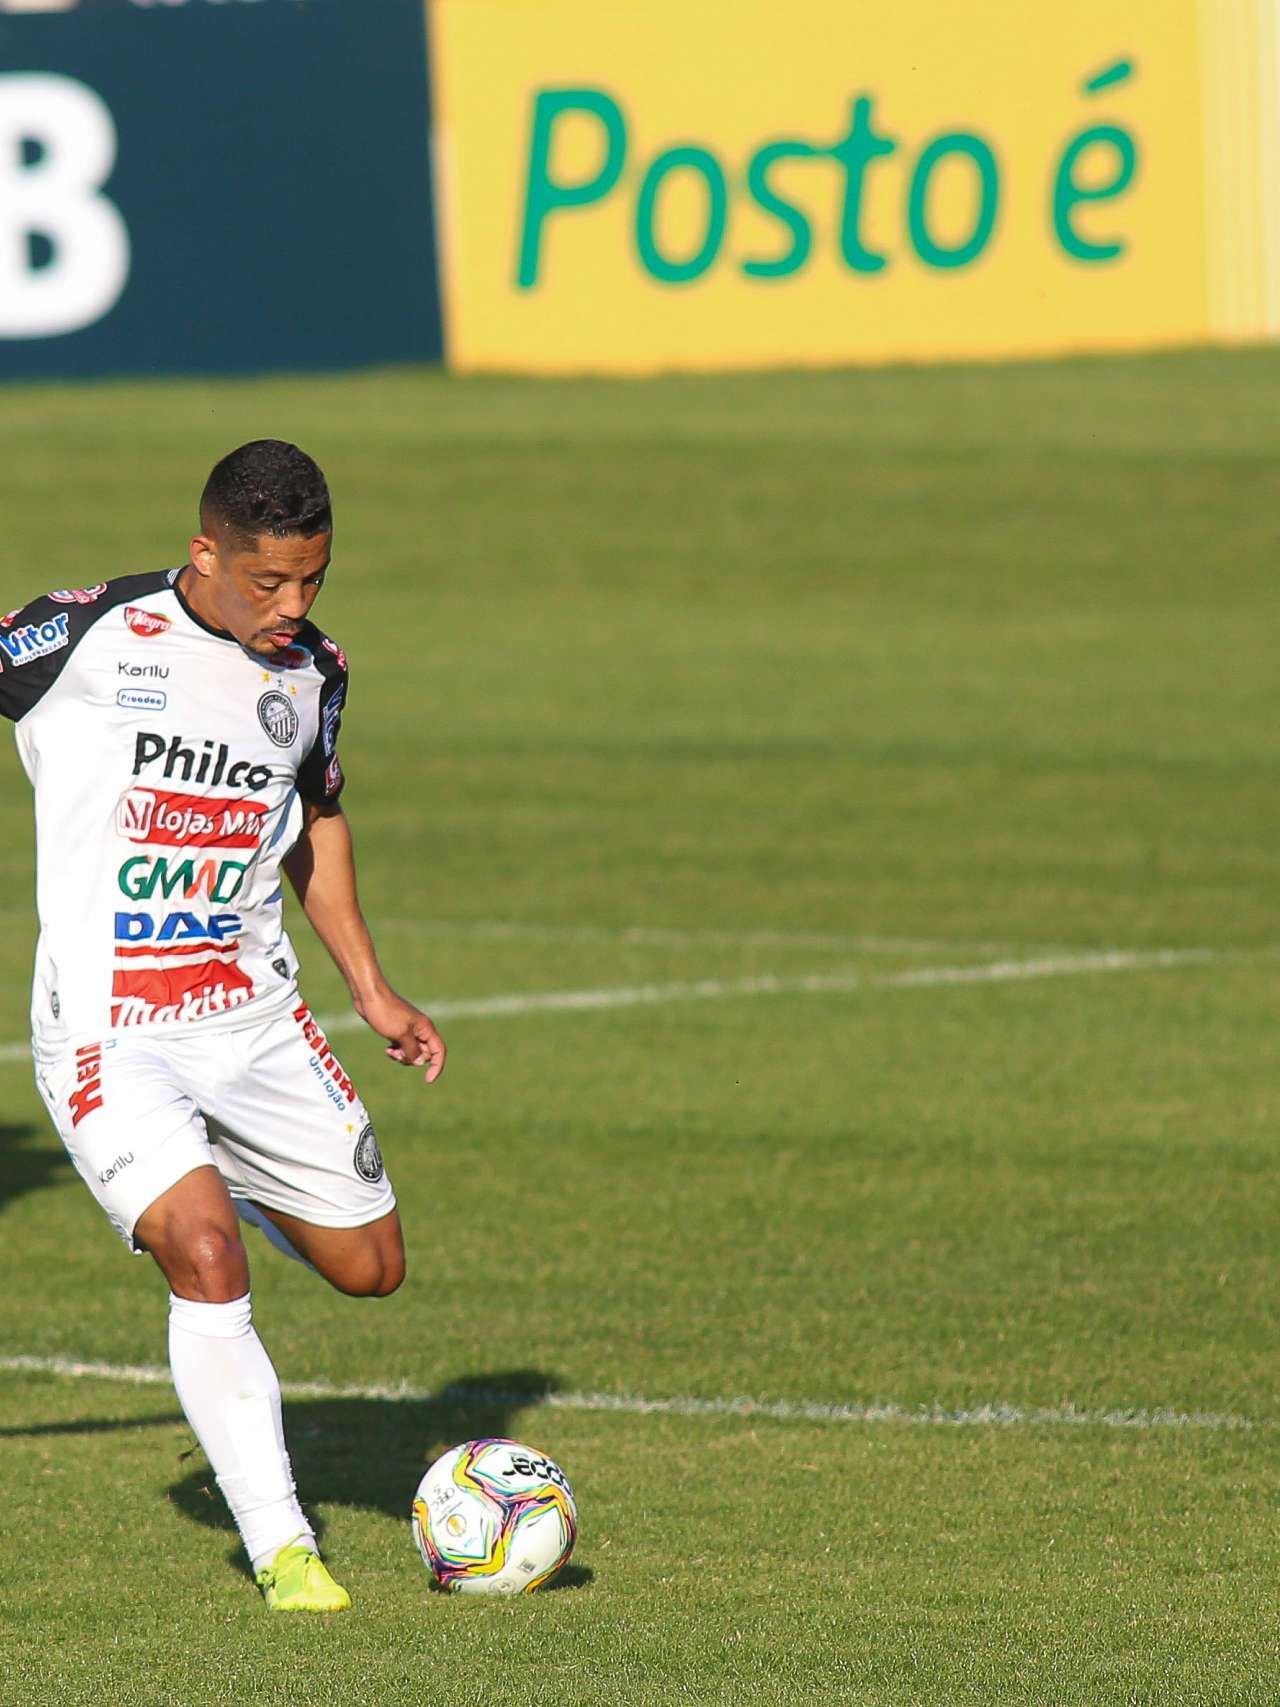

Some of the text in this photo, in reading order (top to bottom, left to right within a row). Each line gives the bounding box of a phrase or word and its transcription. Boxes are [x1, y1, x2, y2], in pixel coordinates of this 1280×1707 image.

[515, 61, 1137, 290] Posto é
[132, 731, 272, 791] Philco
[118, 855, 248, 904] GMAD
[114, 911, 243, 941] DAF
